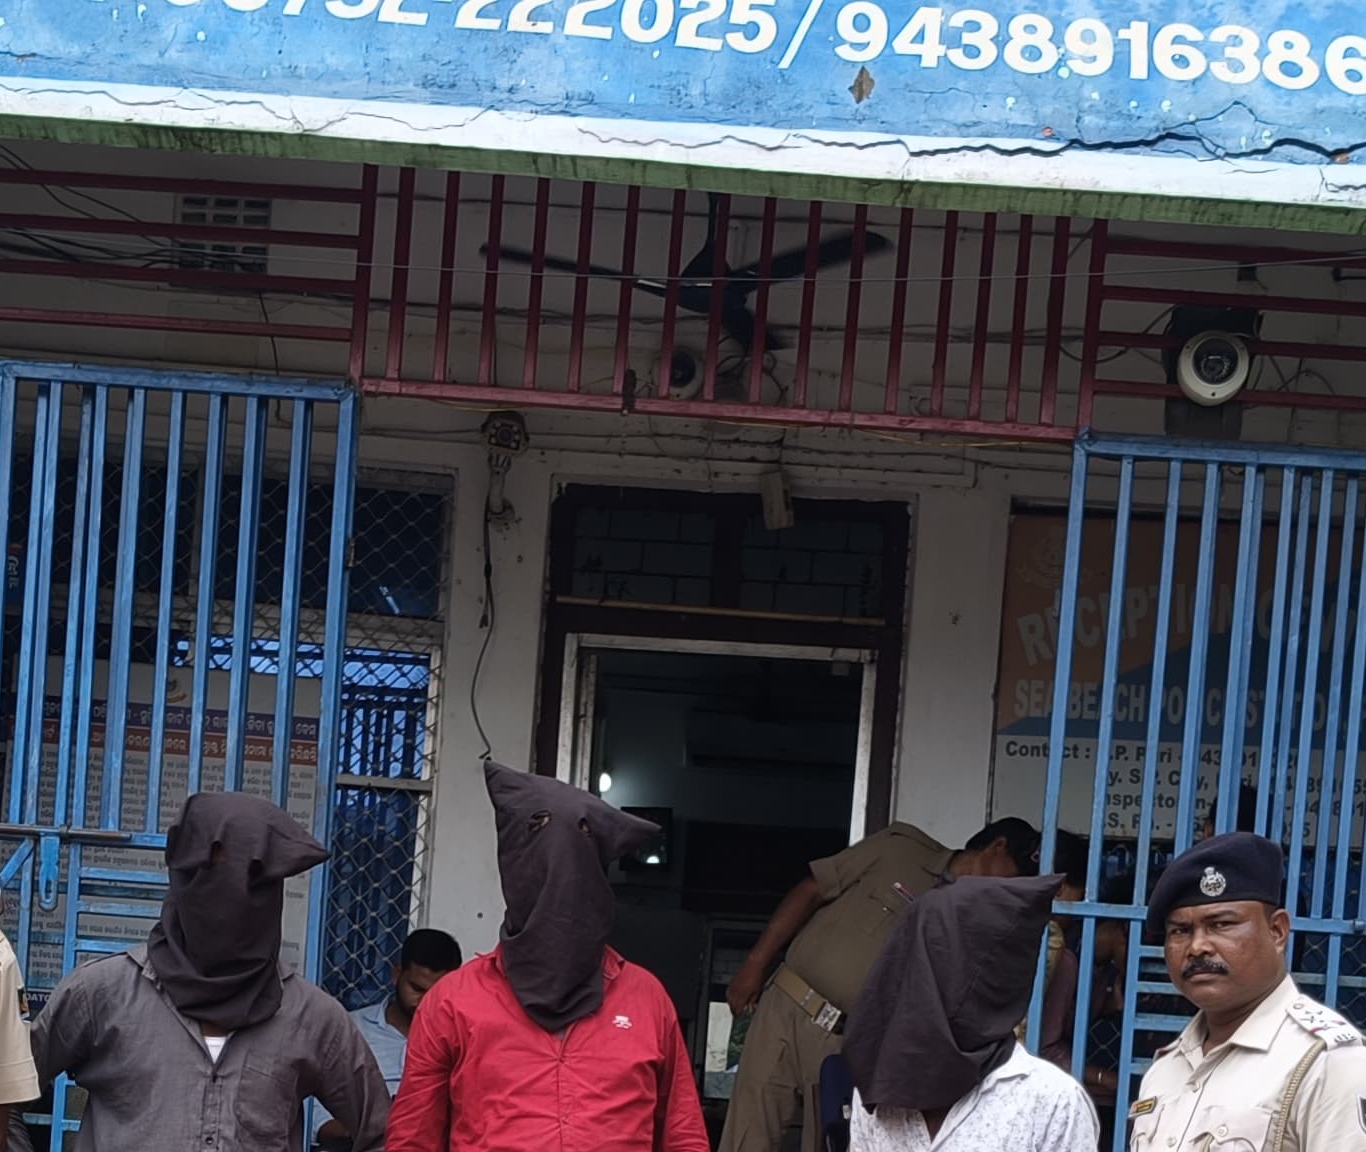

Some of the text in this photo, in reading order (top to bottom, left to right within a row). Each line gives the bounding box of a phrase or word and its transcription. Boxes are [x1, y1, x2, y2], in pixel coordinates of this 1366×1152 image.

[1068, 681, 1146, 723] BECH
[1005, 741, 1079, 760] Contct
[1135, 746, 1172, 763] Pri
